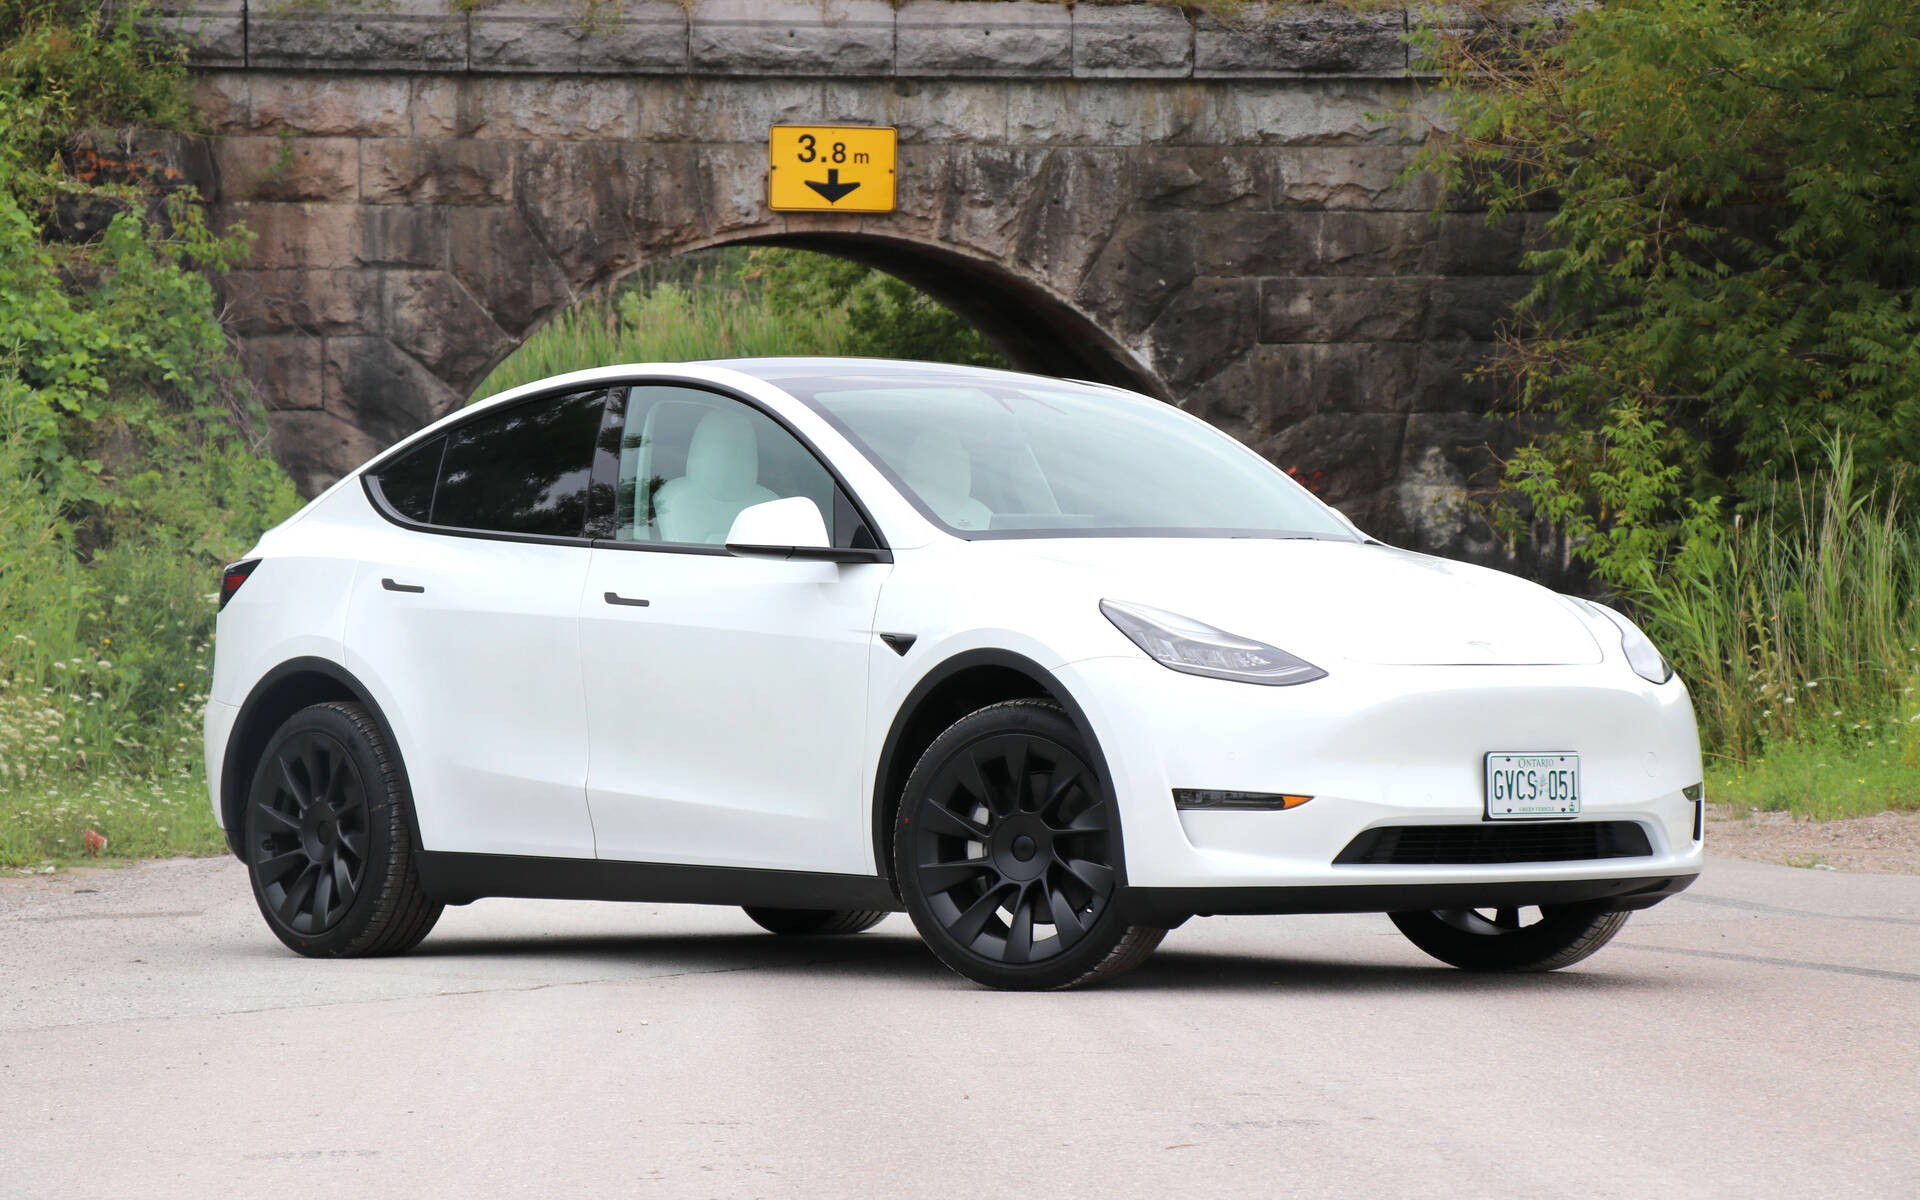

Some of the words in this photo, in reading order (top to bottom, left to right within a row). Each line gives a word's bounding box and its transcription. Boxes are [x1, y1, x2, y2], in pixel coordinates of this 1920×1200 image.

[797, 134, 846, 163] 3.8
[854, 152, 870, 164] m
[1494, 770, 1537, 800] GVCS
[1548, 770, 1577, 800] 051
